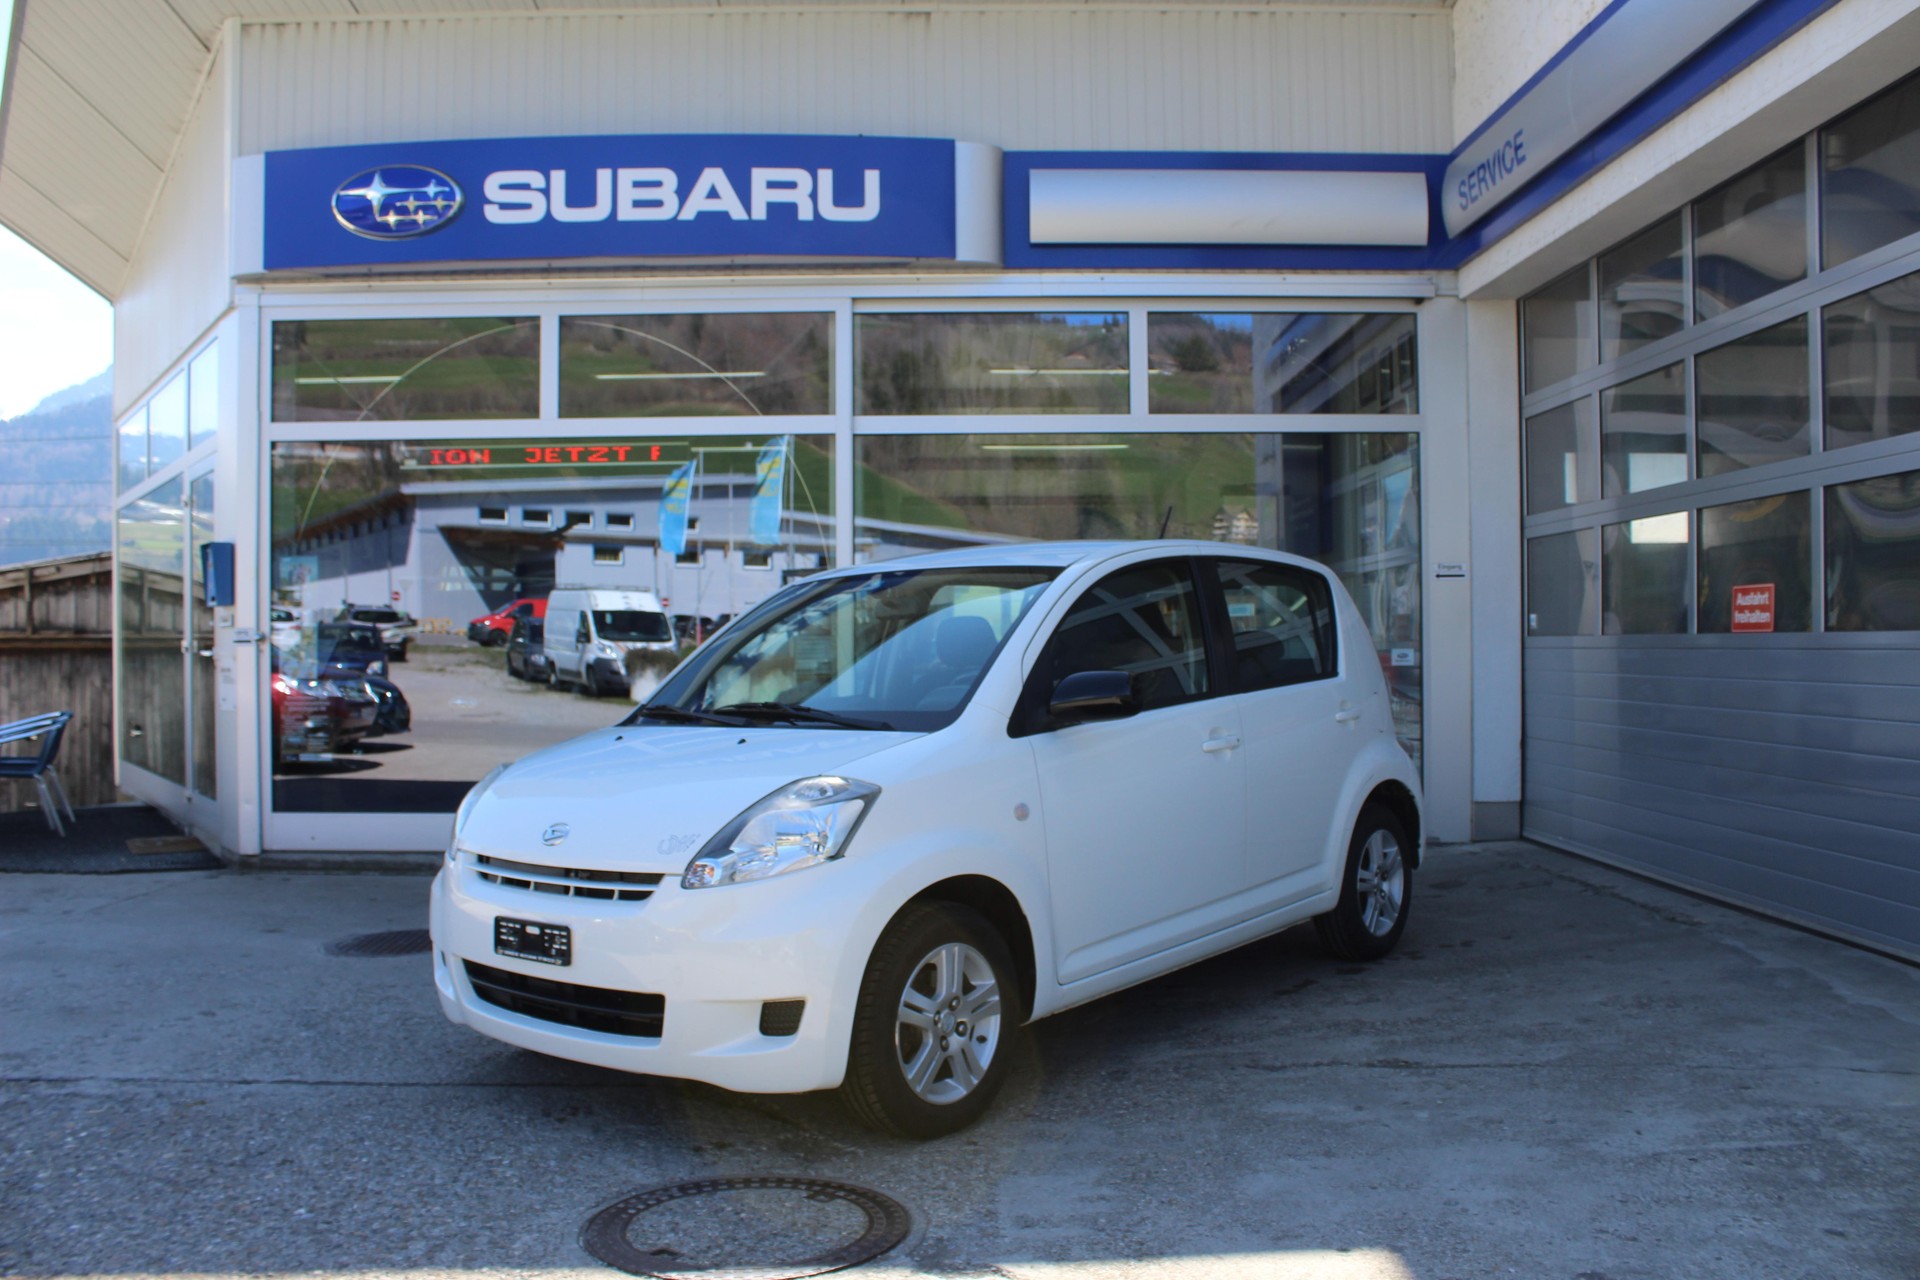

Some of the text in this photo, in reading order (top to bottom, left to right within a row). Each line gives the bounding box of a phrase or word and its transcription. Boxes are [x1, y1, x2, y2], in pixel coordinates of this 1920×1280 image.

[1458, 129, 1527, 211] SERVICE
[483, 167, 881, 225] SUBARU
[525, 446, 632, 463] JETZT
[1736, 592, 1769, 605] Ausfahrt
[1735, 610, 1770, 623] freihalten
